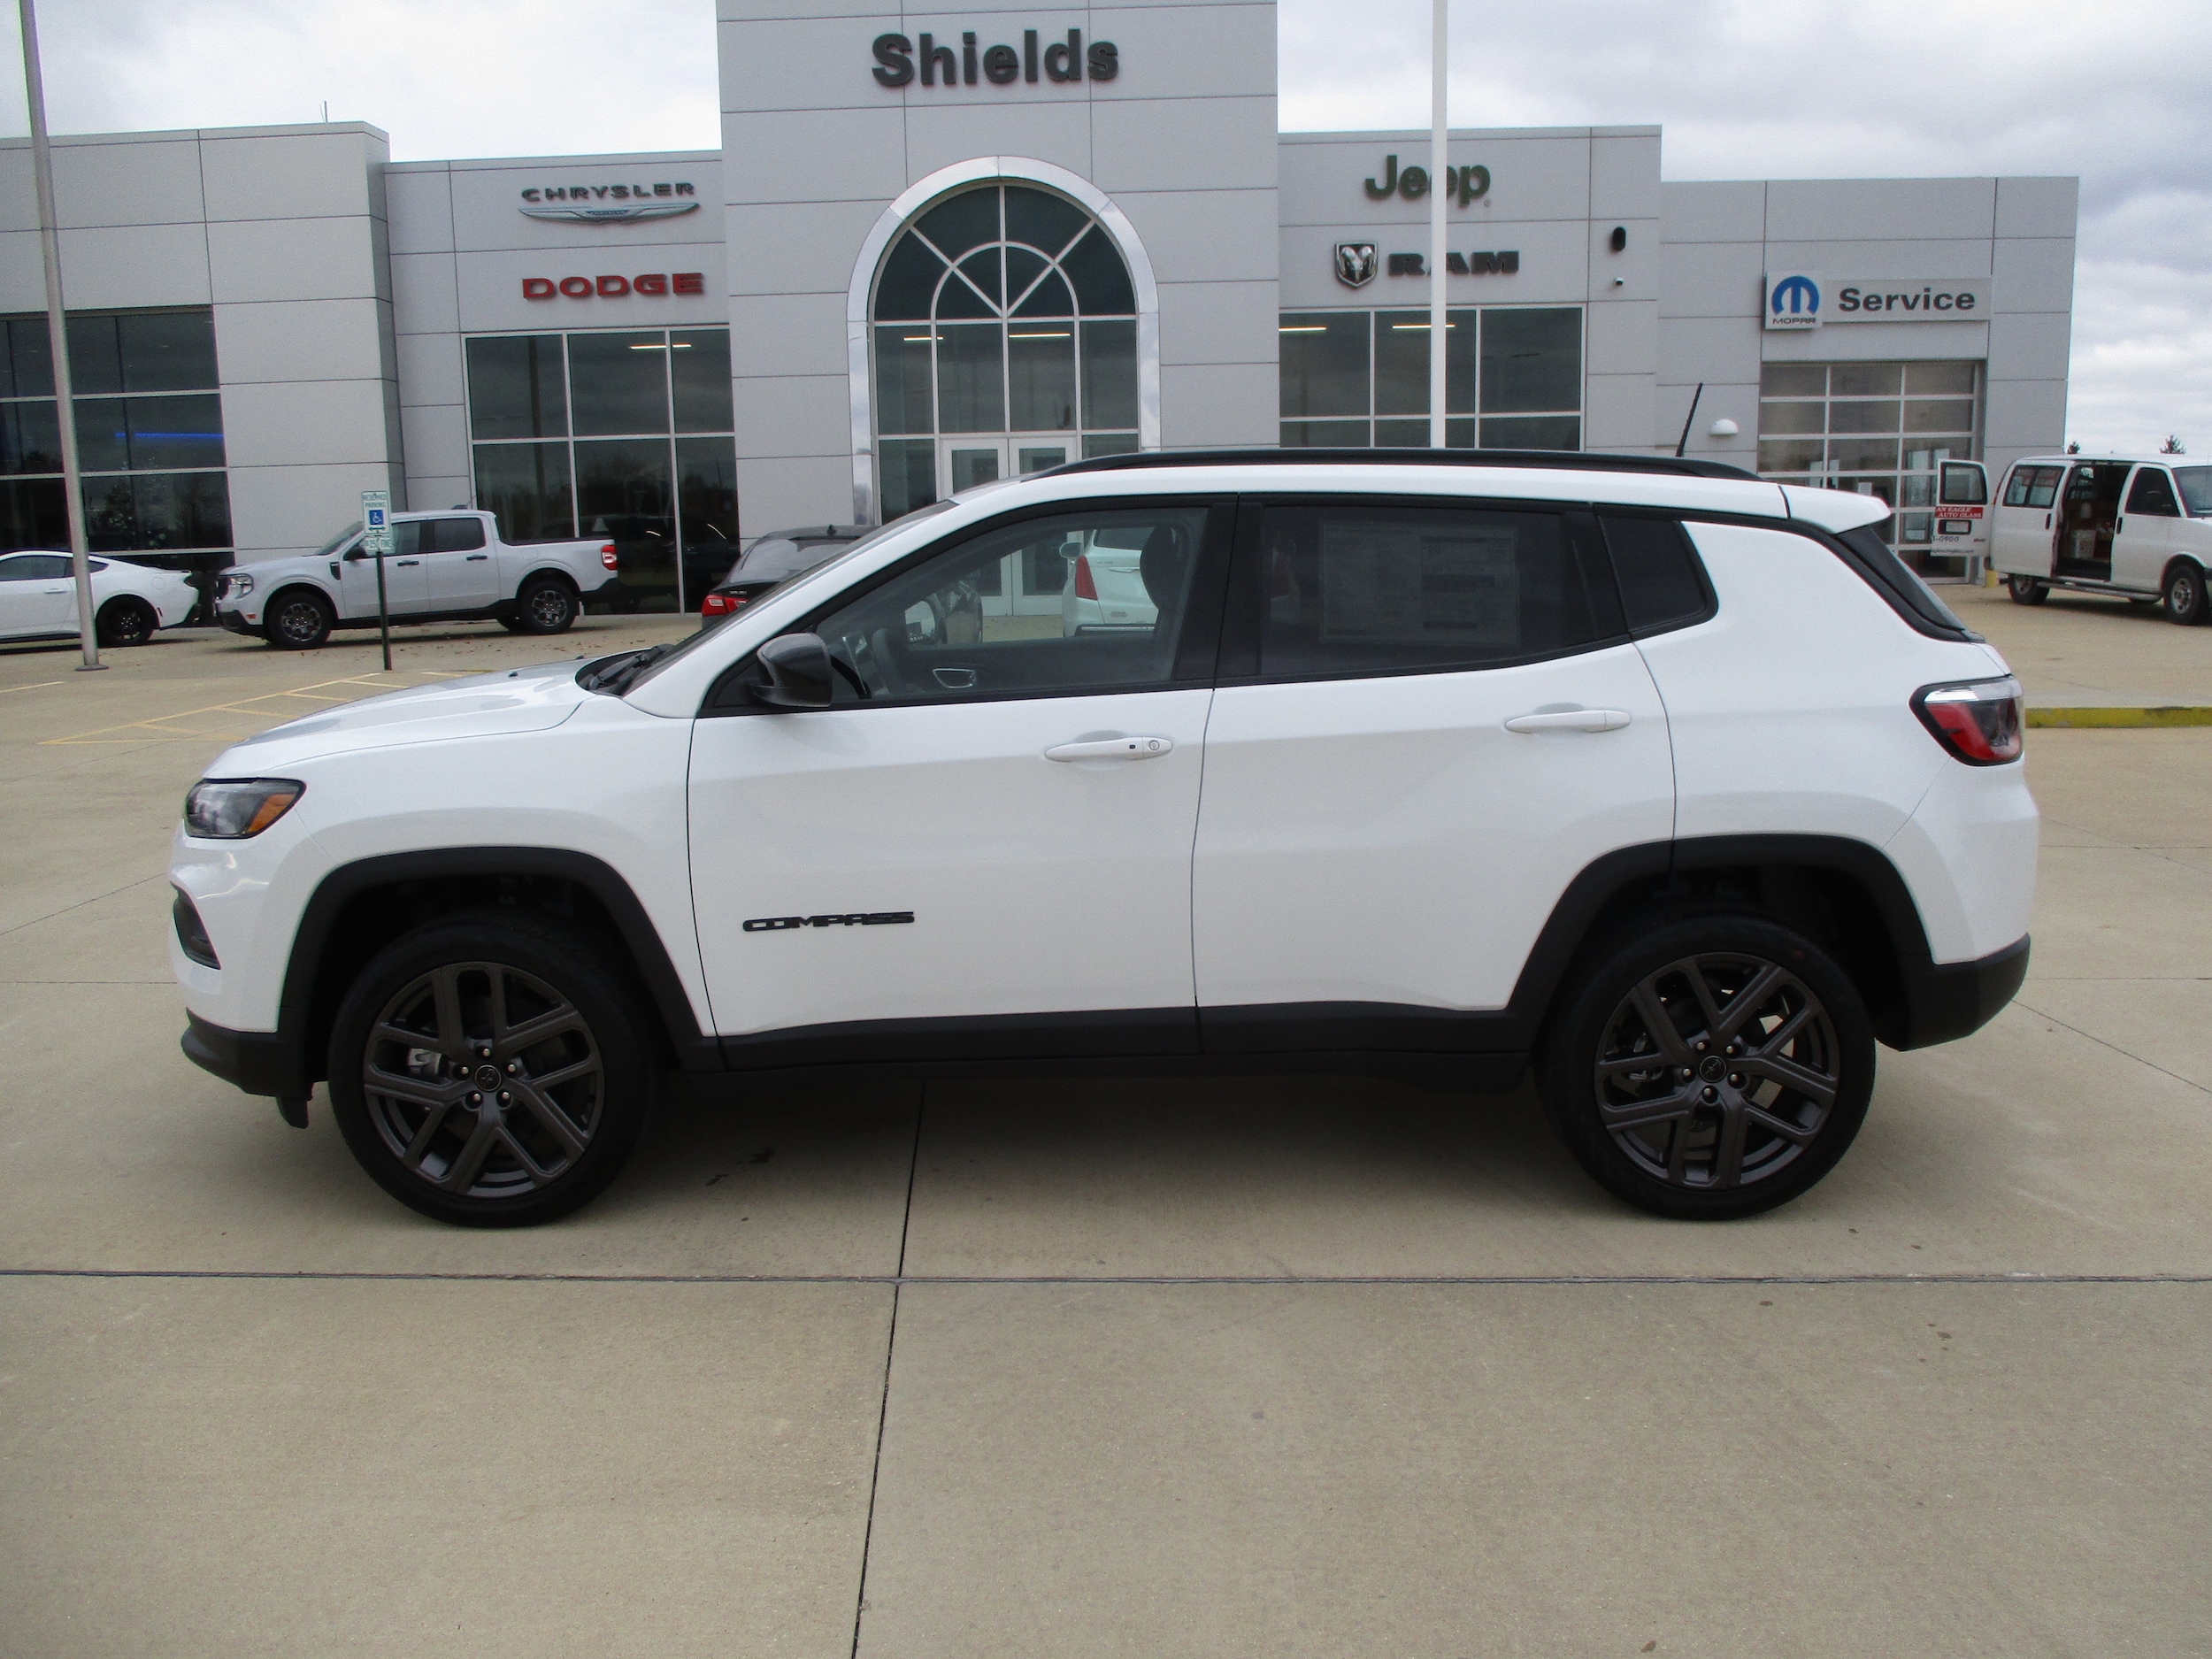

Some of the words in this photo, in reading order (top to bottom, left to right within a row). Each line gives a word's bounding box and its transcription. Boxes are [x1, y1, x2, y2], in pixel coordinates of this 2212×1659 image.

[872, 28, 1119, 87] Shields
[521, 182, 695, 202] CHRYSLER
[1388, 250, 1520, 276] RAM
[522, 273, 703, 299] DODGE
[1838, 287, 1976, 312] Service
[743, 911, 915, 932] COMPASS
